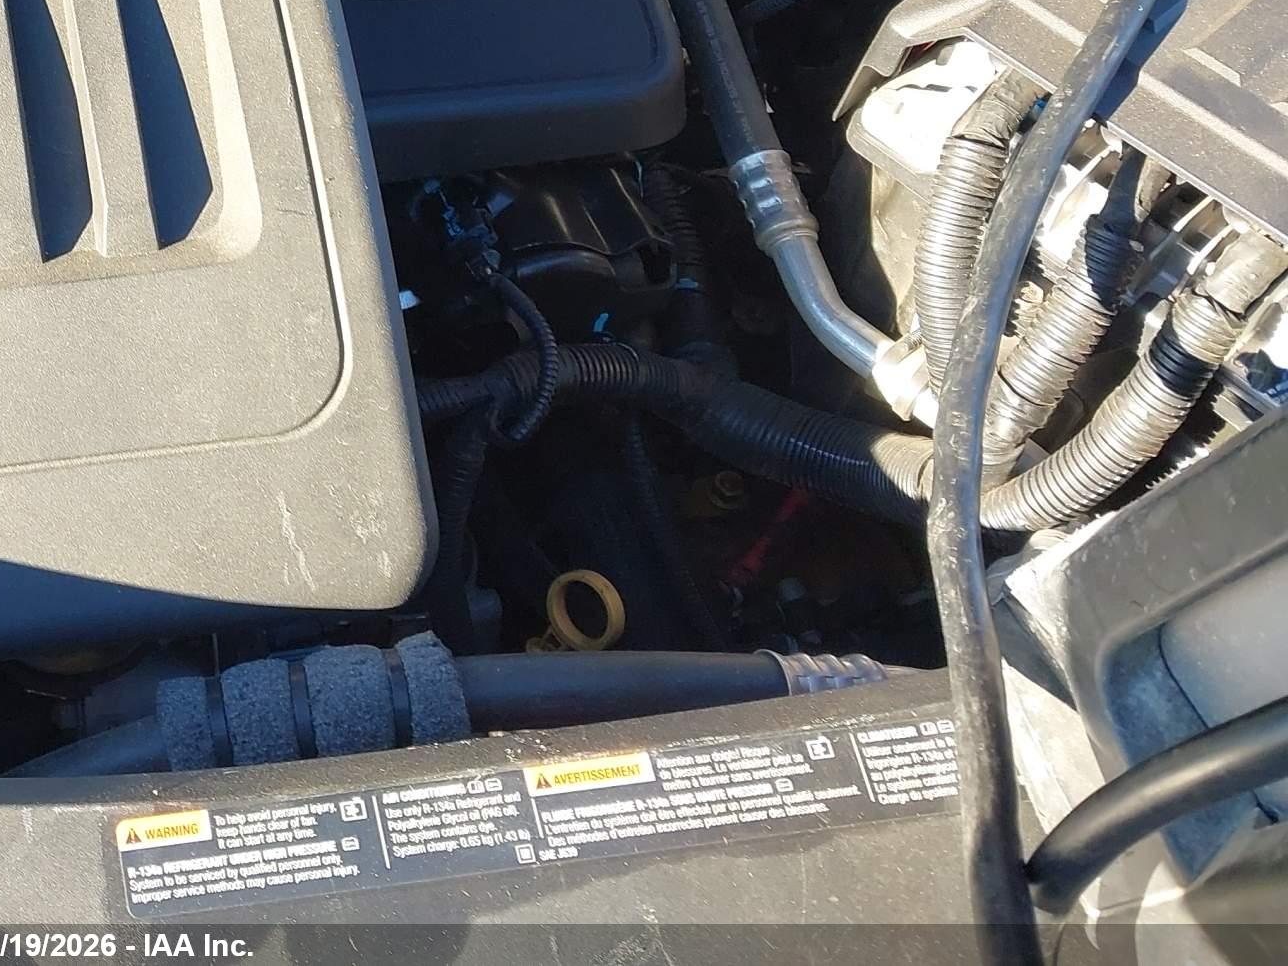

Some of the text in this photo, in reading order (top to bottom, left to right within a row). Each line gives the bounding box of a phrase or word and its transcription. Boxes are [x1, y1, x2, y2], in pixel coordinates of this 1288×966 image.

[553, 763, 640, 785] AVERTISSEMENT
[214, 816, 225, 825] To
[226, 813, 246, 826] help
[247, 810, 271, 823] avoid
[272, 805, 309, 821] personal
[385, 792, 521, 818] Use only R-134a Refrigerant and
[216, 827, 238, 837] keep
[239, 823, 266, 836] hands
[267, 820, 288, 831] clear
[290, 817, 299, 828] of
[442, 811, 468, 825] Glycol
[469, 810, 480, 820] oil
[144, 822, 200, 840] WARNING
[218, 829, 316, 849] It can start at any time.
[390, 822, 497, 843] The system contains dye.
[393, 842, 426, 858] System
[427, 841, 459, 852] charge:
[460, 835, 481, 847] 0.65
[481, 835, 494, 846] kg
[539, 849, 556, 860] SAE
[127, 865, 163, 878] R-134a
[130, 854, 343, 894] System to be serviced by qualified personnel only.
[131, 865, 360, 903] Improper service methods may cause personal injury.
